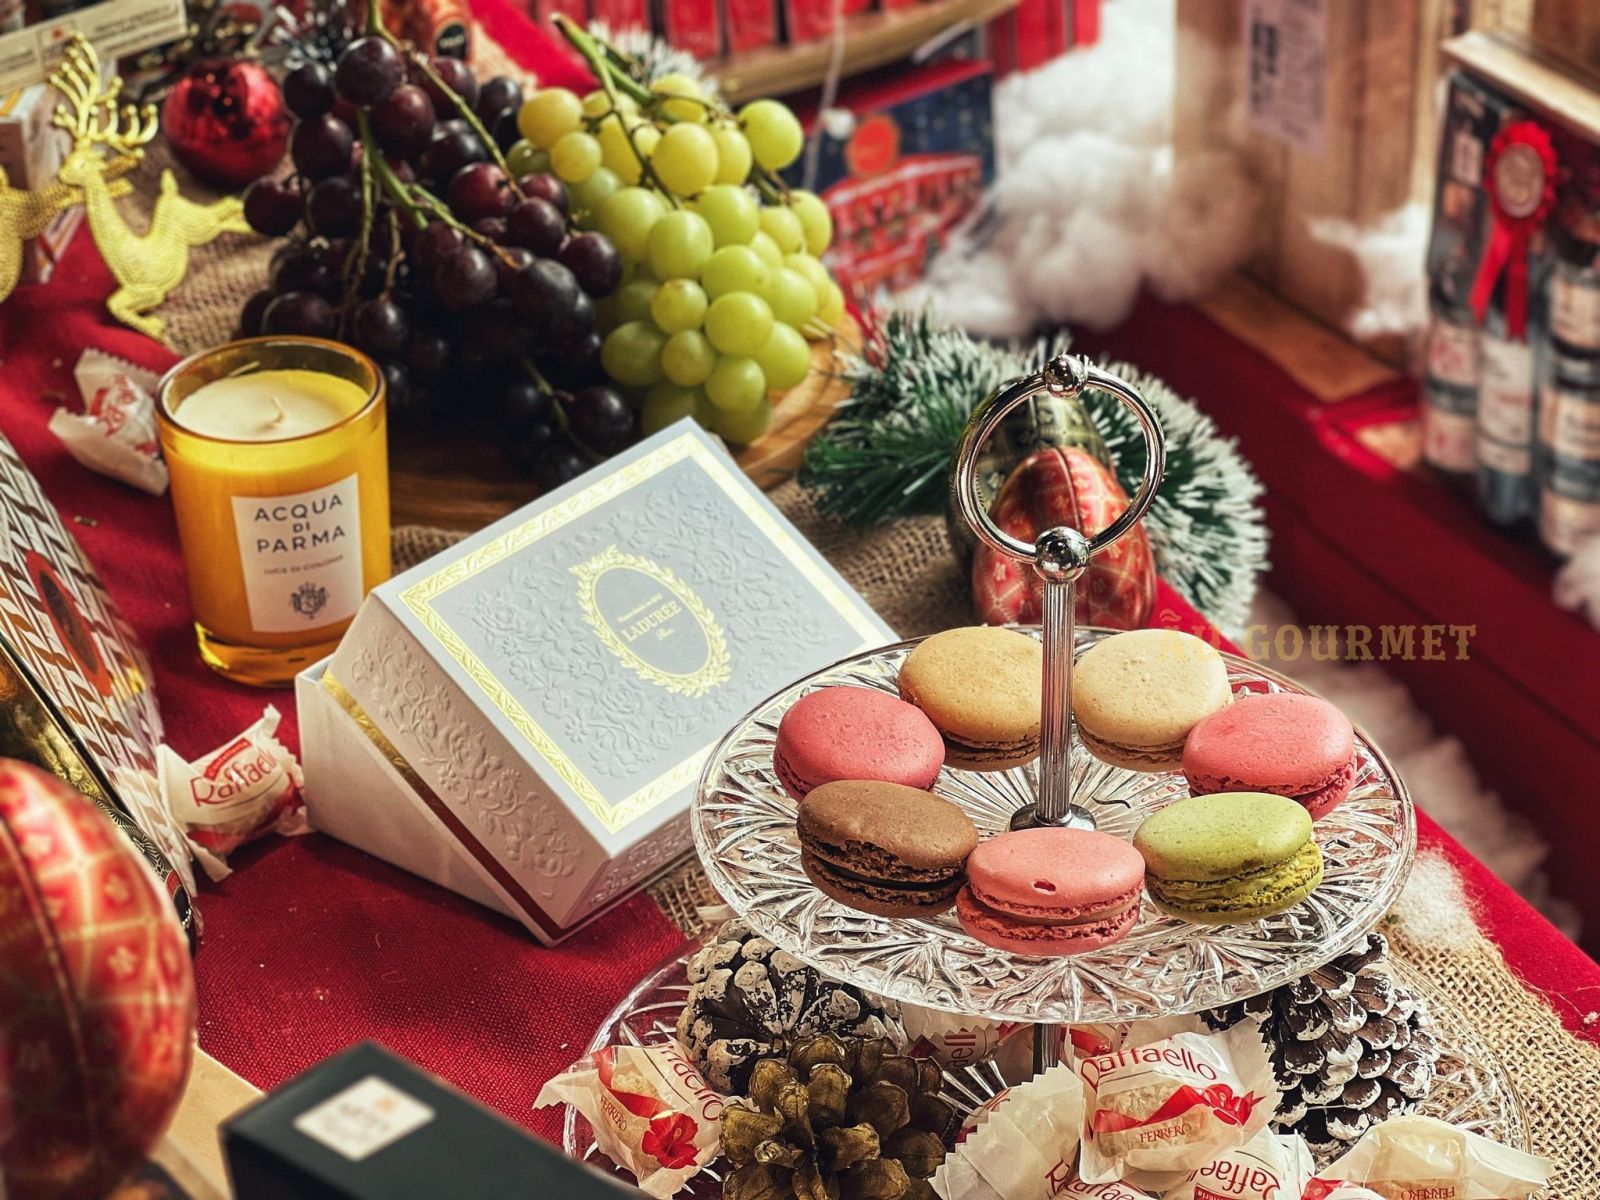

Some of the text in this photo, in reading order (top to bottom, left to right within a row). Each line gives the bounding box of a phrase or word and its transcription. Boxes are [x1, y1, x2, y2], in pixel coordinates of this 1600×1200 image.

[253, 493, 343, 522] ACQUA
[257, 525, 346, 553] PARMA
[292, 521, 311, 533] DI
[600, 1095, 628, 1132] FERRERO
[1139, 1123, 1192, 1143] FERRERO
